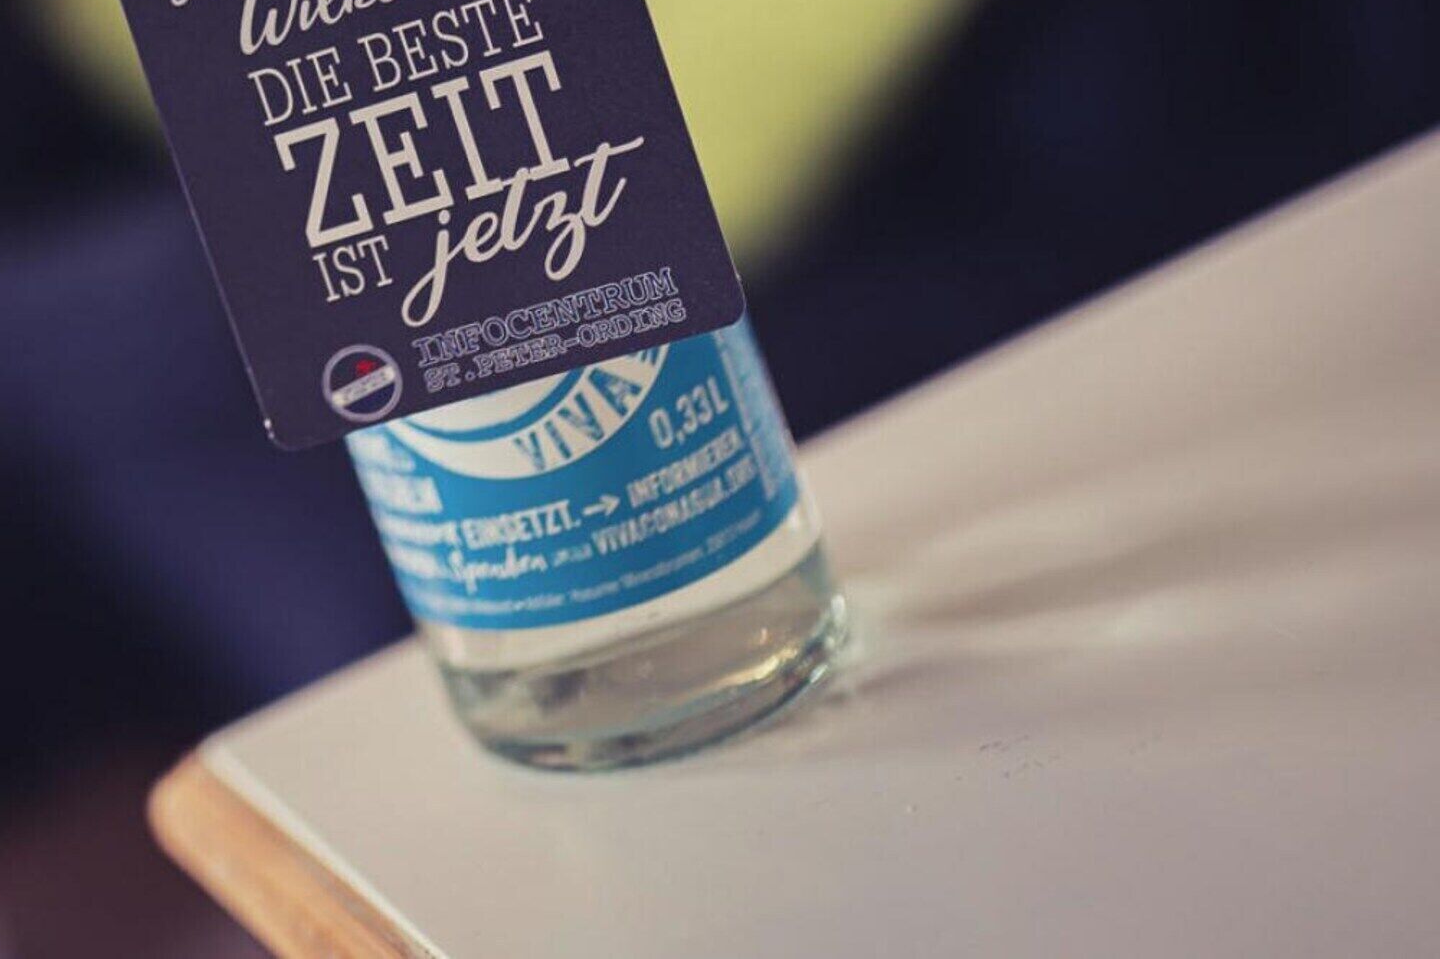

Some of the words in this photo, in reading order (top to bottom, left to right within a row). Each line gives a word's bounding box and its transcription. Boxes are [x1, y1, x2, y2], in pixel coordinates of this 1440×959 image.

[248, 46, 352, 127] DIE
[273, 50, 571, 249] ZEIT
[312, 235, 393, 303] IST
[401, 137, 645, 328] jetzt
[412, 267, 678, 369] INFOCENTRUM
[513, 367, 644, 472] VIVA
[648, 374, 729, 450] 0,33L
